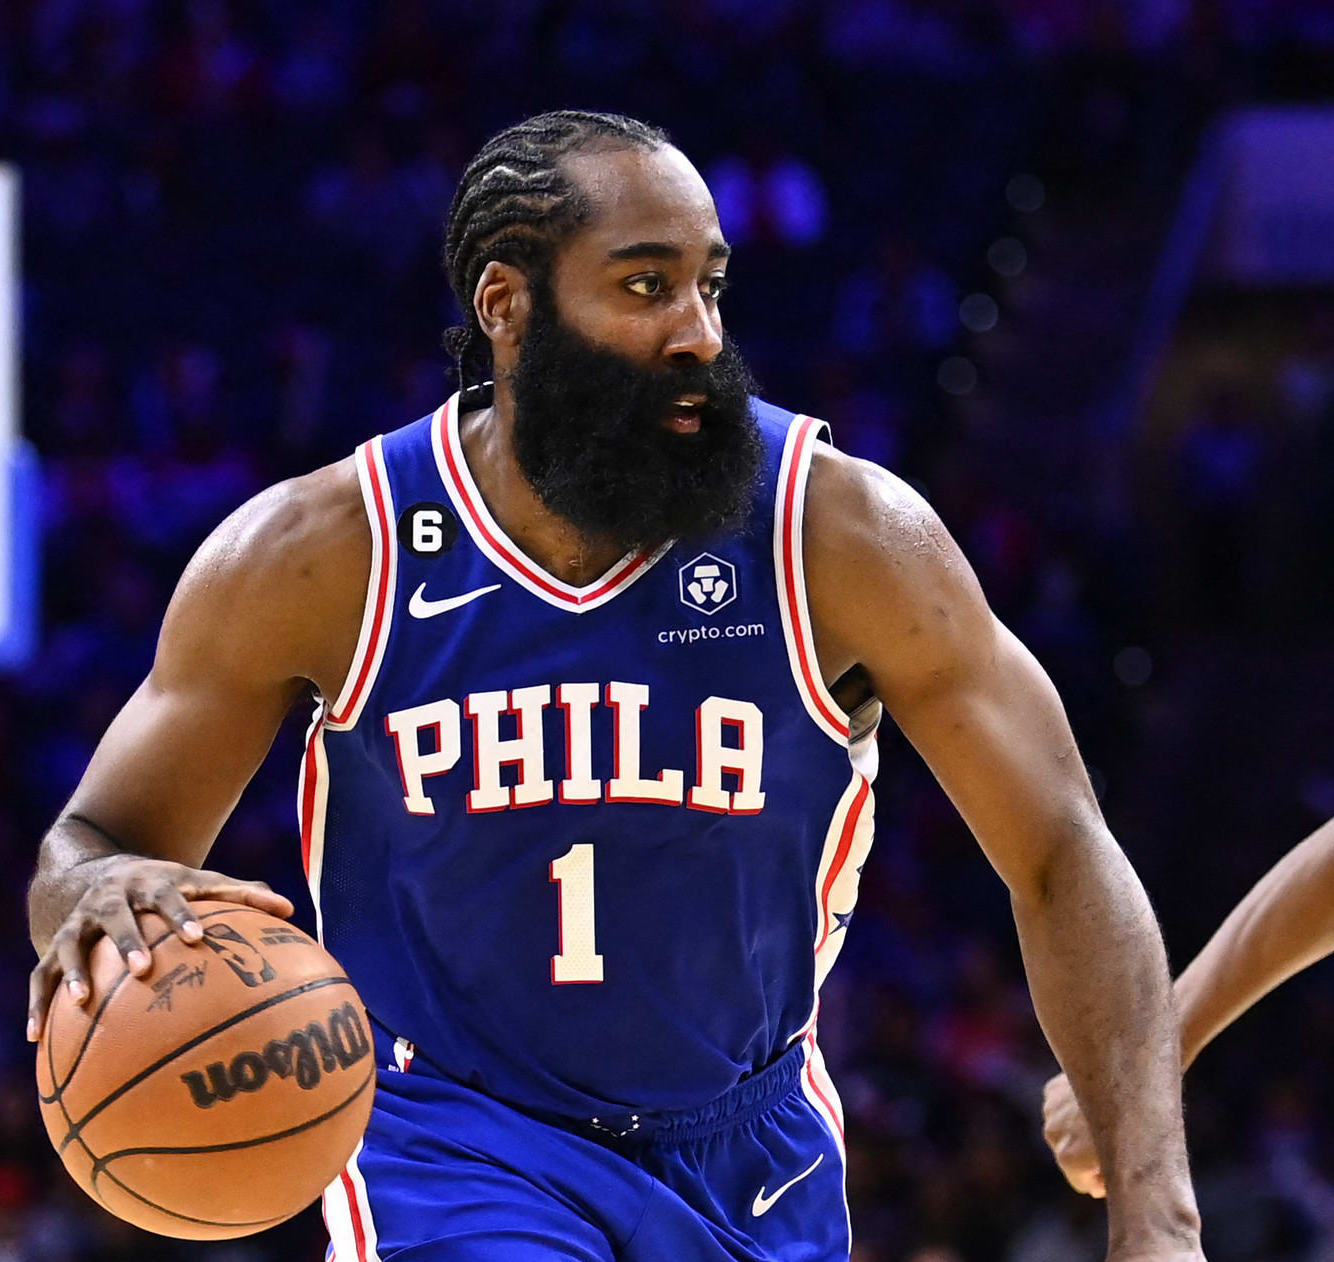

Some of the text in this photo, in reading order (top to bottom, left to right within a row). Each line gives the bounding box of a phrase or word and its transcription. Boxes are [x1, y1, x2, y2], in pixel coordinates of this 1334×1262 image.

[412, 510, 443, 552] 6
[657, 622, 765, 645] crypto.com
[385, 681, 766, 816] PHILA
[548, 843, 604, 985] 1
[180, 1000, 371, 1110] Wilson
